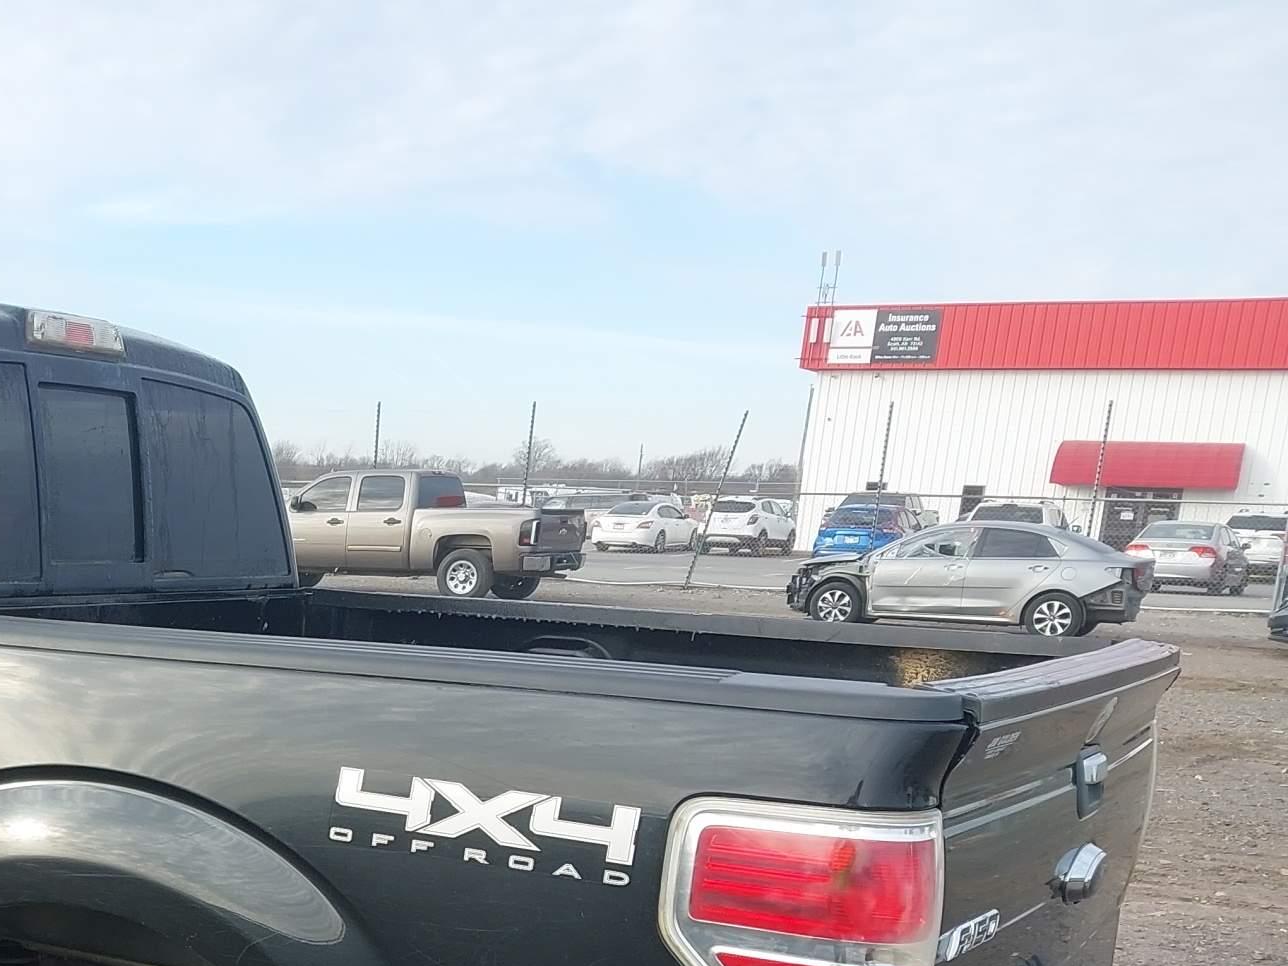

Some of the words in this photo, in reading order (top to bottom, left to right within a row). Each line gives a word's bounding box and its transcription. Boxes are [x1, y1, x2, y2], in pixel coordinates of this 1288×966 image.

[888, 313, 929, 322] Insurance
[878, 323, 897, 332] Auto
[899, 323, 936, 332] Auctions
[462, 847, 631, 888] ROAD
